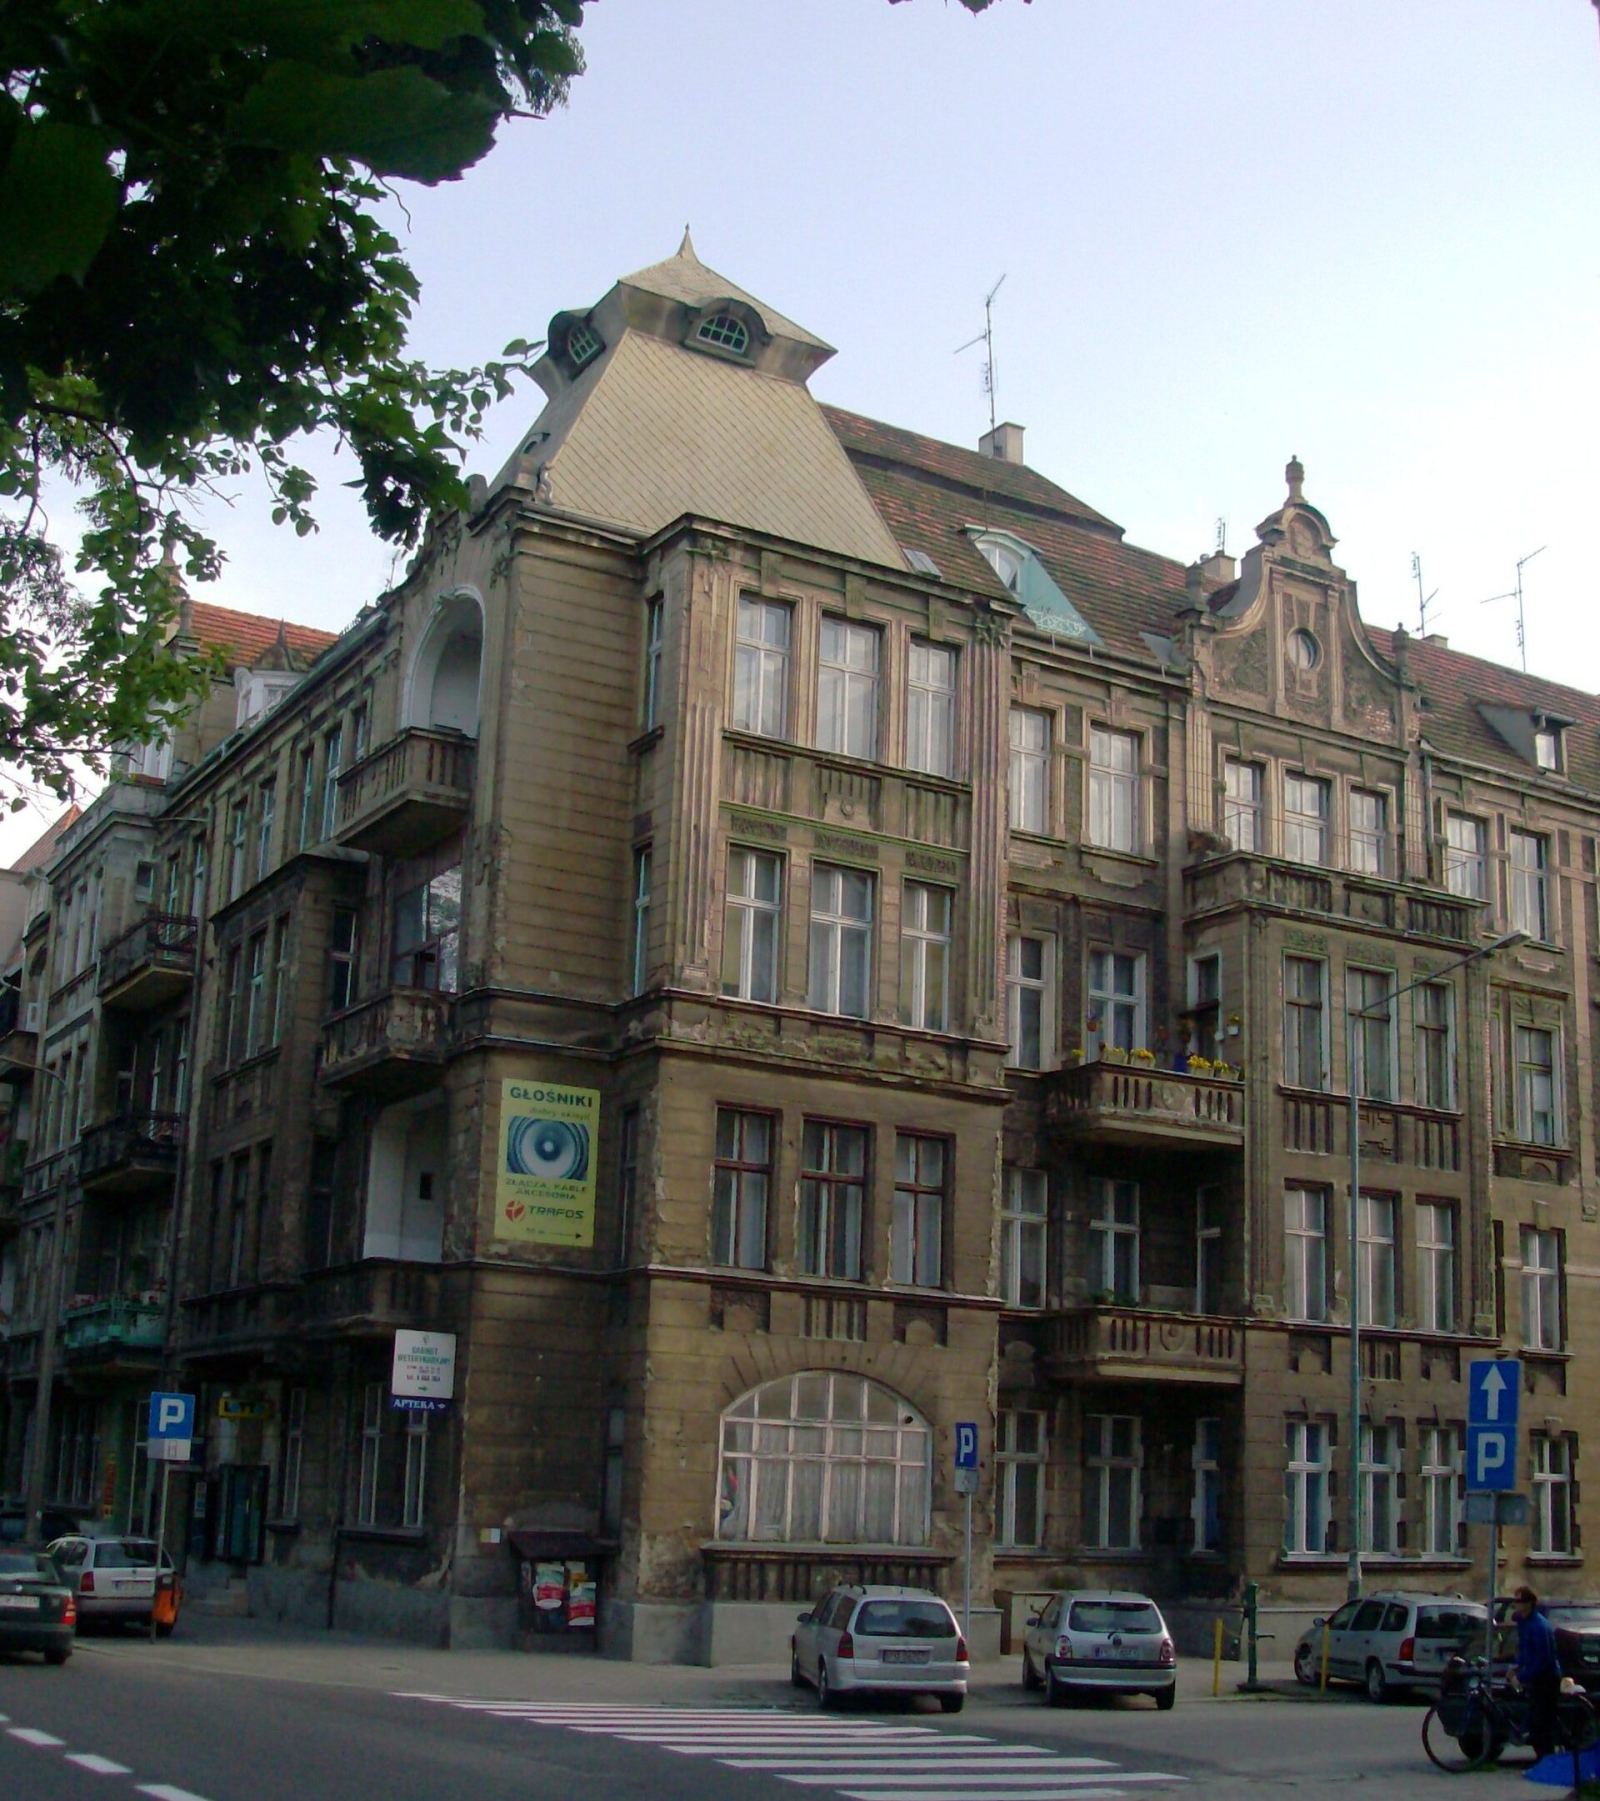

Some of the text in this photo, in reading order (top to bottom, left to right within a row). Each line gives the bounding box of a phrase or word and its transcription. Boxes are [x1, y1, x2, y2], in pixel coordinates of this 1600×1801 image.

[510, 1086, 592, 1108] GŁOŚNIKI
[515, 1188, 576, 1200] AKCESORIA
[529, 1205, 584, 1220] TRAFOS
[159, 1398, 185, 1433] P
[393, 1399, 435, 1410] APTEKA
[960, 1427, 974, 1463] P
[1477, 1432, 1506, 1482] P
